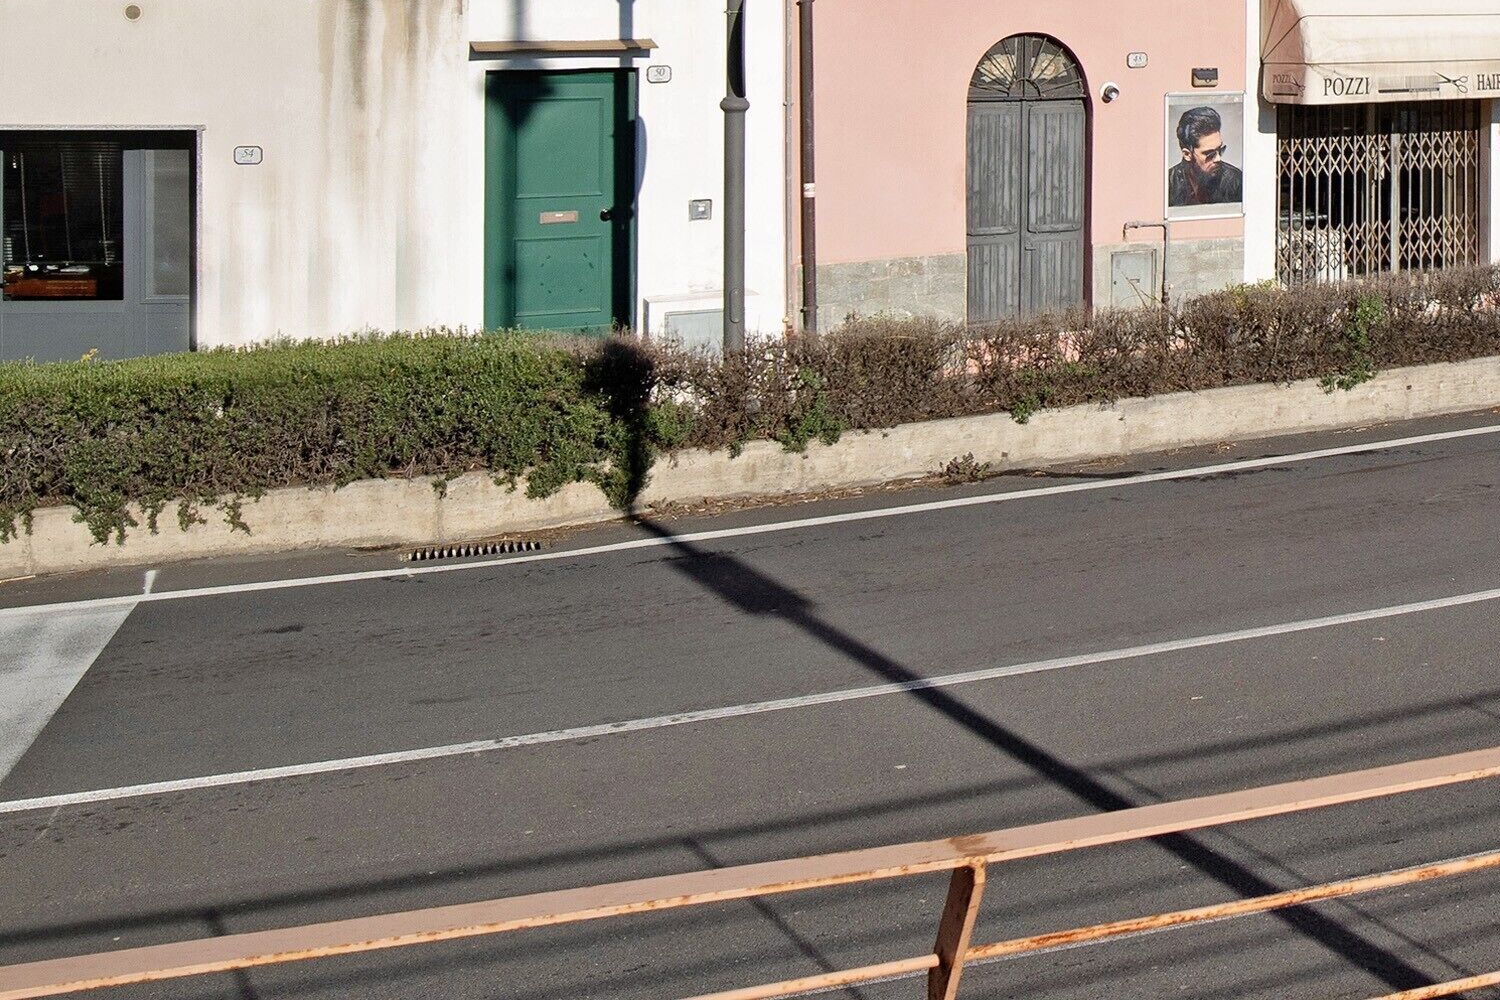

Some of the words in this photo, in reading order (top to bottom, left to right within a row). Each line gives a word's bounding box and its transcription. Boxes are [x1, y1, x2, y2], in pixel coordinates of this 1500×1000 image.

[1272, 73, 1291, 84] POZZI
[1323, 77, 1370, 96] POZZI
[240, 148, 255, 159] 54
